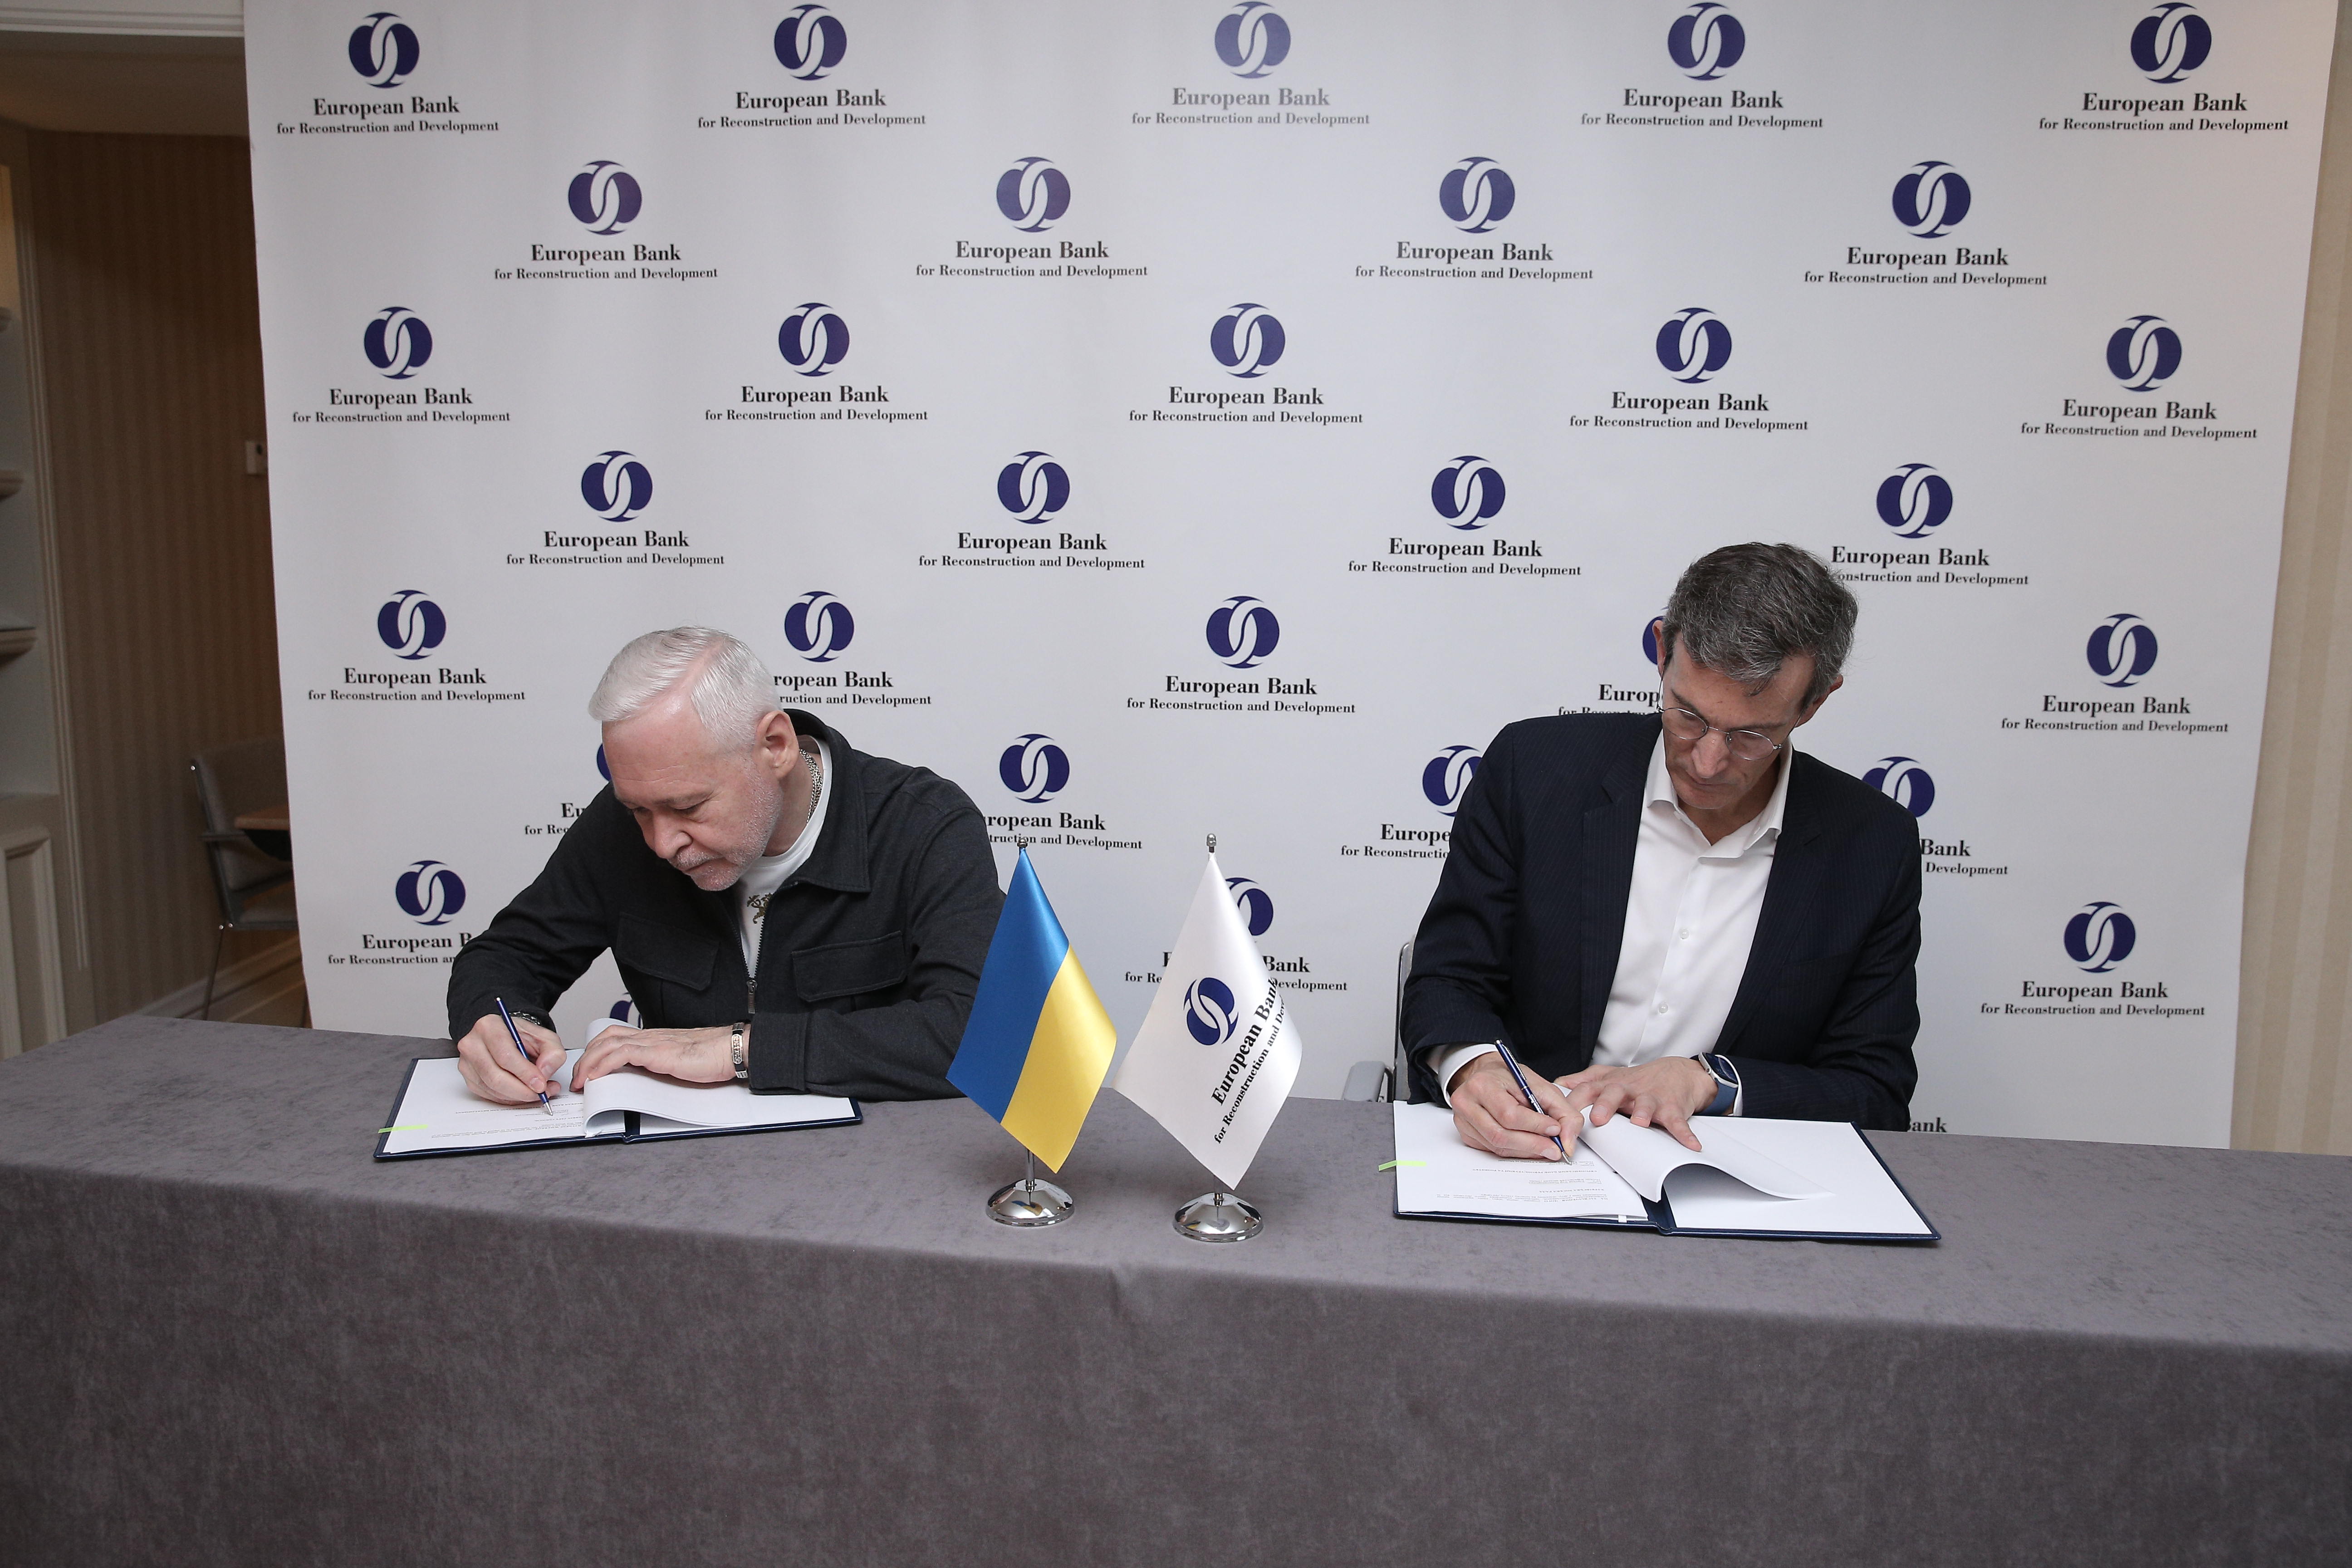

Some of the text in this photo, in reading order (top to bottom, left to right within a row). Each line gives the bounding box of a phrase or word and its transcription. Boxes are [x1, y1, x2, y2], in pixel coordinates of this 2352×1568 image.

[314, 96, 460, 120] European Bank
[736, 89, 886, 113] European Bank
[1174, 88, 1328, 110] European Bank
[1624, 88, 1784, 113] European Bank
[2082, 93, 2247, 117] European Bank
[277, 120, 499, 134] for Reconstruction and Development
[698, 113, 925, 128] for Reconstruction and Development
[1133, 113, 1368, 127] for Reconstruction and Development
[1582, 113, 1823, 130] for Reconstruction and Development
[2039, 118, 2288, 134] for Reconstruction and Development
[531, 244, 681, 266] European Bank
[956, 240, 1109, 264] European Bank
[1396, 241, 1553, 265] European Bank
[1847, 247, 2009, 270] European Bank
[495, 267, 717, 281] for Reconstruction and Development
[916, 265, 1147, 279] for Reconstruction and Development
[1356, 265, 1593, 282] for Reconstruction and Development
[1804, 271, 2047, 288] for Reconstruction and Development
[330, 387, 473, 410] European Bank
[741, 385, 889, 407] European Bank
[1169, 386, 1324, 409] European Bank
[1612, 392, 1769, 415] European Bank
[293, 411, 510, 425] for Reconstruction and Development
[706, 409, 927, 423] for Reconstruction and Development
[1130, 410, 1362, 426] for Reconstruction and Development
[2063, 399, 2217, 423] European Bank
[1570, 415, 1808, 433] for Reconstruction and Development
[2021, 422, 2257, 441] for Reconstruction and Development
[544, 530, 690, 552] European Bank
[958, 532, 1107, 554] European Bank
[1388, 538, 1543, 560] European Bank
[507, 553, 724, 567] for Reconstruction and Development
[919, 555, 1145, 571] for Reconstruction and Development
[1831, 546, 1989, 569] European Bank
[1348, 560, 1581, 578] for Reconstruction and Development
[1838, 571, 2028, 588] onstruction and Development
[344, 667, 487, 689] European Bank
[774, 671, 894, 691] ropean Bank
[1165, 676, 1317, 698] European Bank
[308, 690, 525, 703] for Reconstruction and Development
[779, 693, 931, 708] ruction and Development
[1598, 684, 1659, 707] Europ
[1127, 697, 1355, 715] for Reconstruction and Development
[2043, 695, 2190, 718] European Bank
[2001, 718, 2228, 735] for Reconstruction and Development
[524, 825, 543, 835] for
[984, 812, 1106, 831] ropean Bank
[1040, 834, 1062, 844] and
[1066, 834, 1142, 851] Development
[1380, 823, 1450, 846] Europe
[1341, 845, 1449, 859] for Reconstructio
[1921, 838, 1971, 857] Bank
[1926, 862, 2008, 877] Development
[362, 934, 452, 953] European
[328, 954, 345, 964] for
[349, 954, 438, 964] Reconstruction
[1262, 955, 1310, 973] Bank
[1125, 971, 1143, 982] for
[2021, 981, 2168, 1002] European Bank
[1981, 1003, 2205, 1018] for Reconstruction and Development
[1211, 978, 1277, 1106] European Bank
[1214, 1127, 1226, 1144] for
[1222, 1049, 1269, 1127] Reconstruction
[1267, 1025, 1280, 1047] and
[1911, 1117, 1947, 1133] ank
